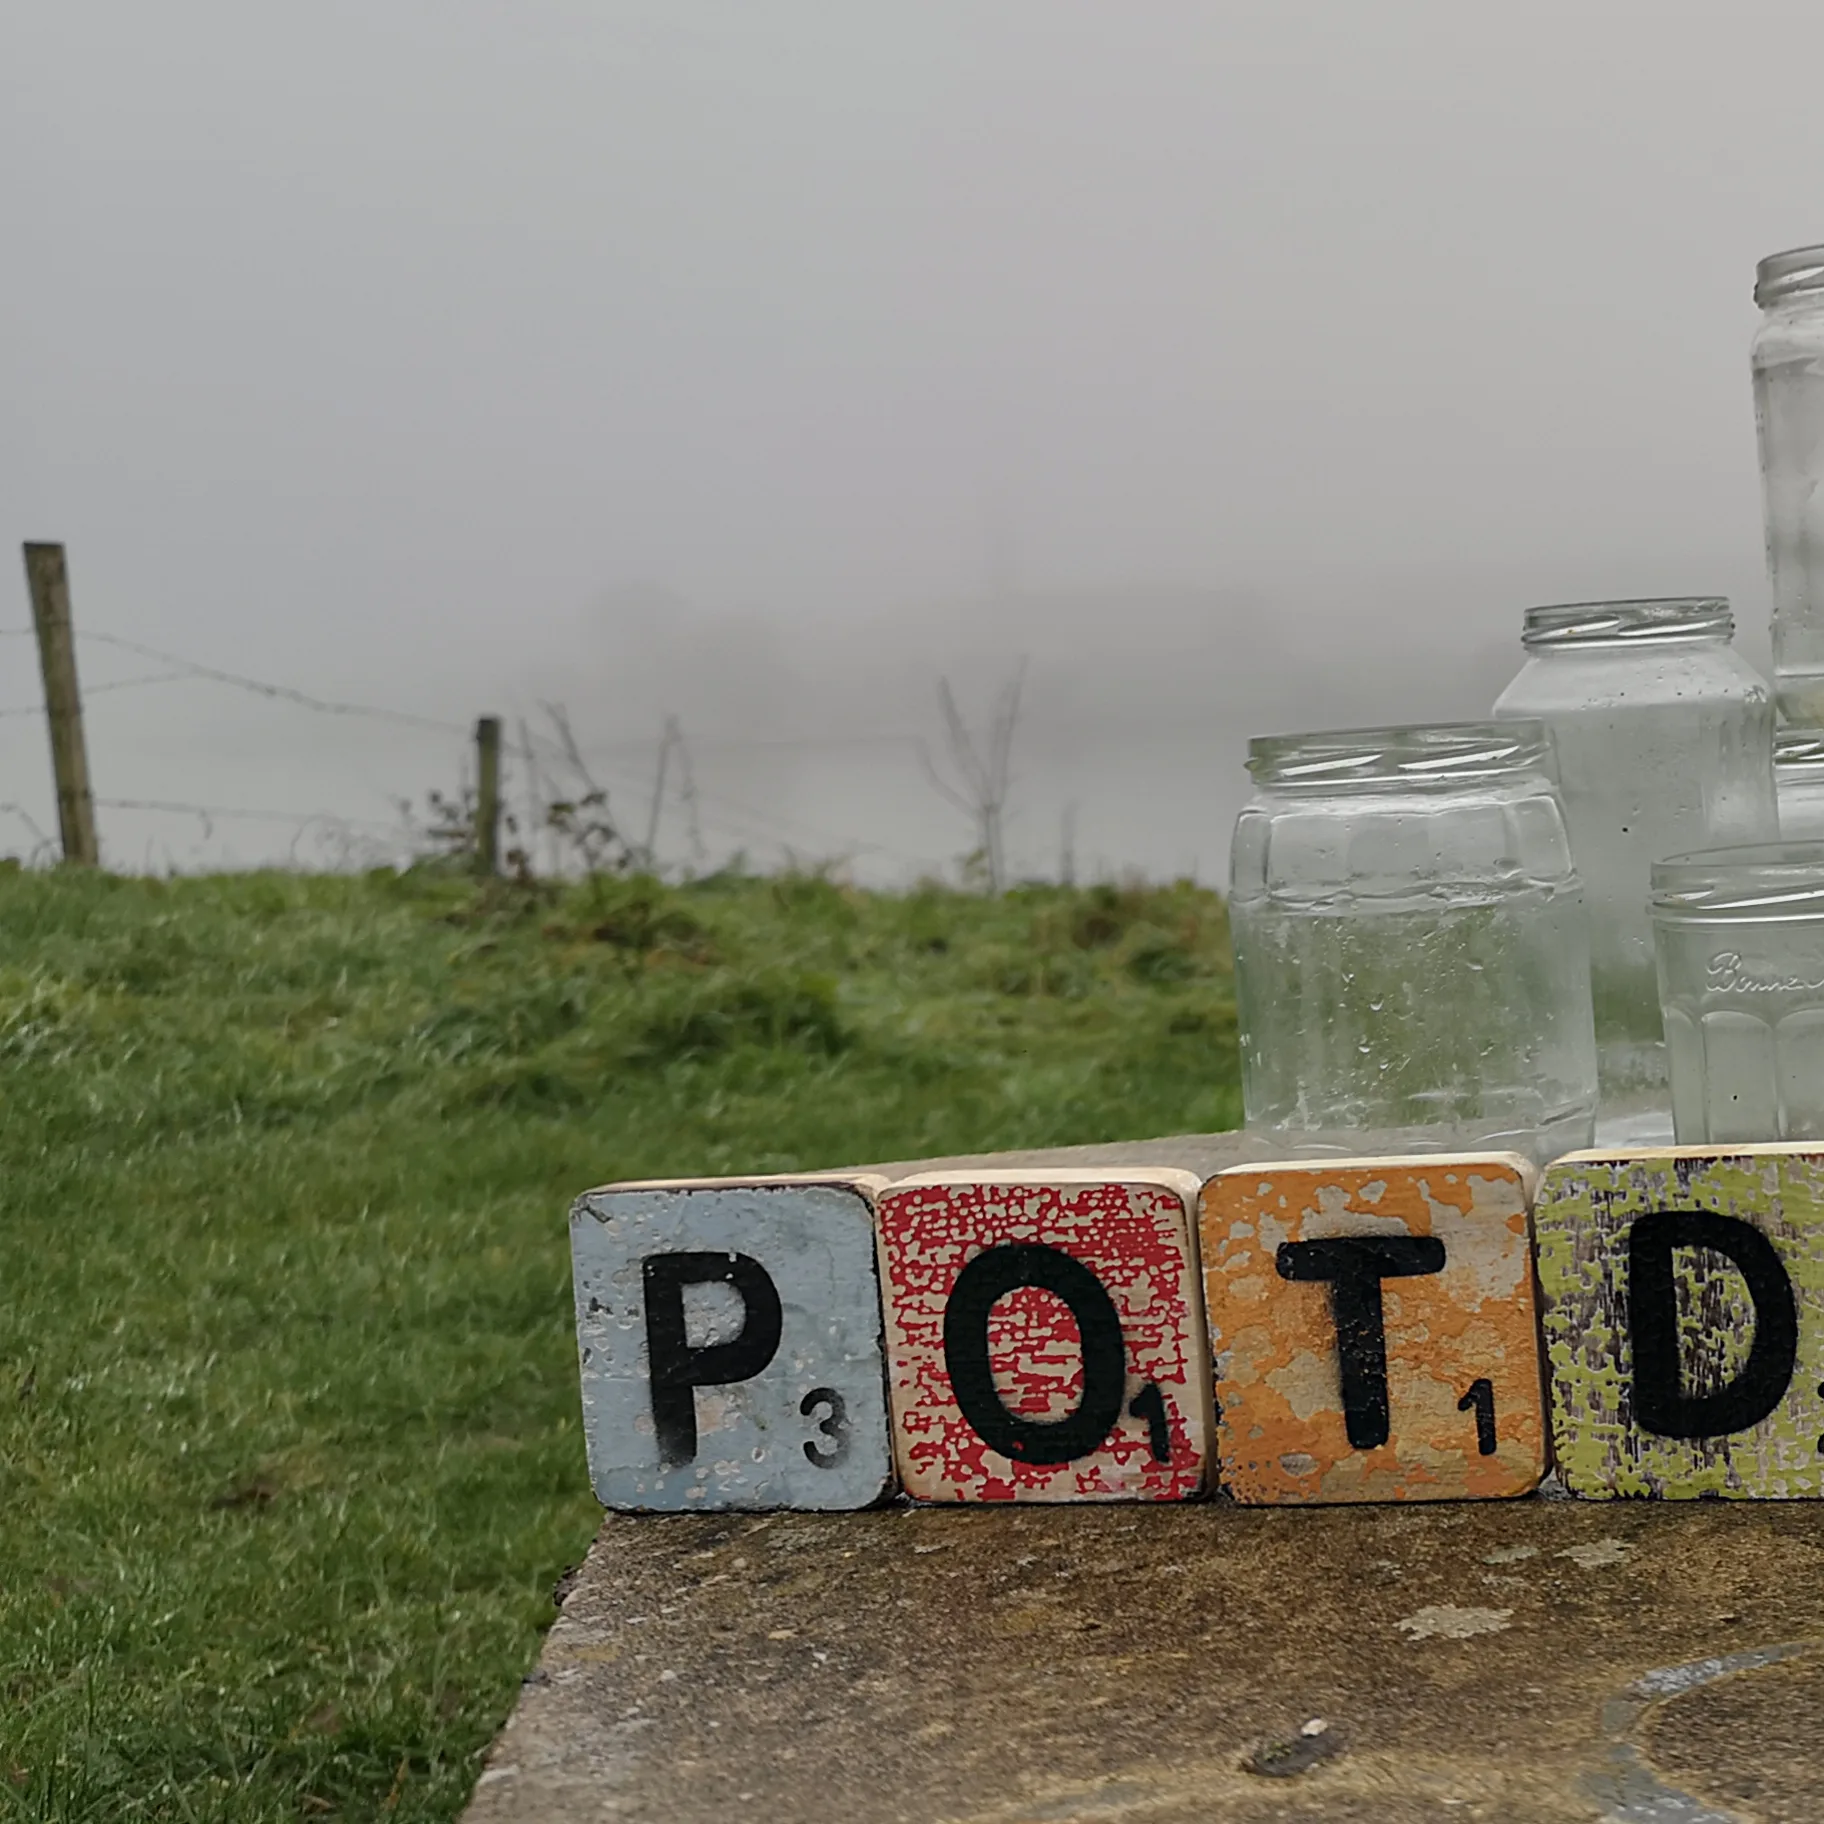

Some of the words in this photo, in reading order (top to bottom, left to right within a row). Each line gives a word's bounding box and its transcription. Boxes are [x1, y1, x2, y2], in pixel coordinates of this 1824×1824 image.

[800, 1387, 848, 1469] 3
[1128, 1382, 1170, 1465] 1
[1457, 1379, 1497, 1456] 1
